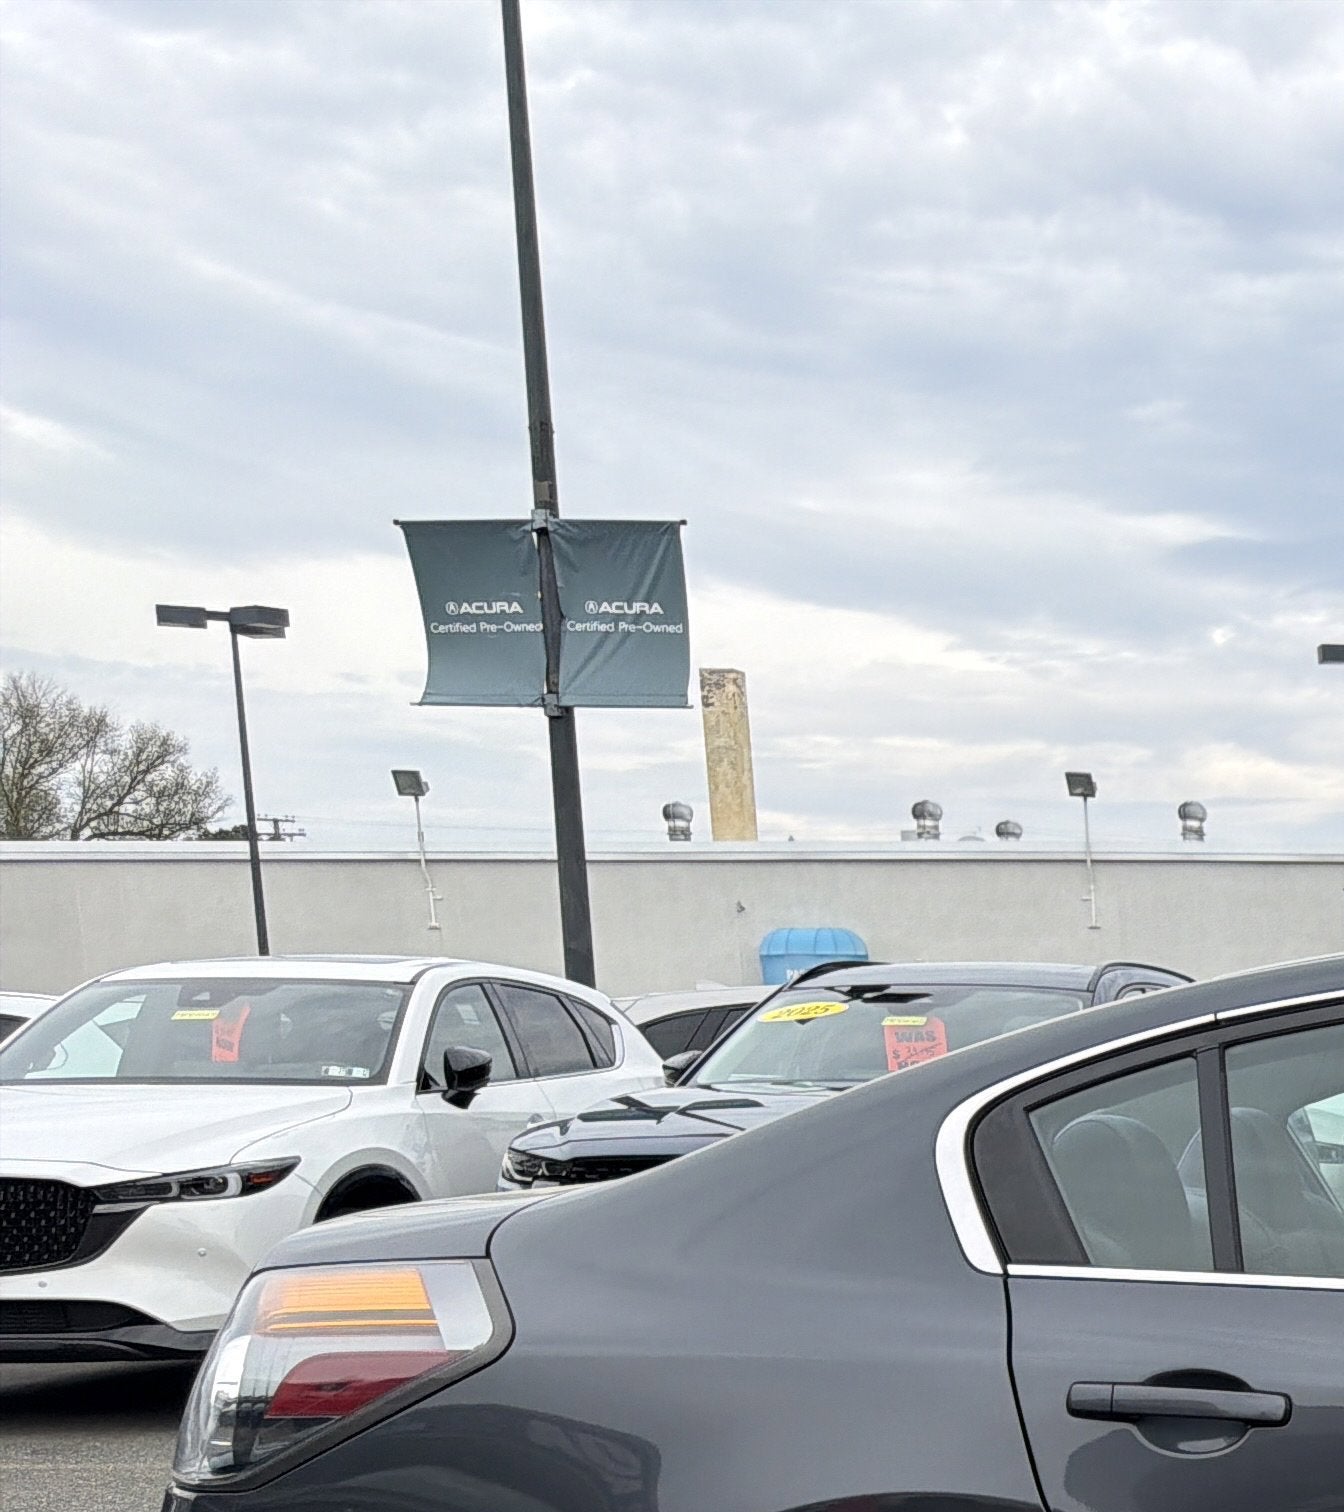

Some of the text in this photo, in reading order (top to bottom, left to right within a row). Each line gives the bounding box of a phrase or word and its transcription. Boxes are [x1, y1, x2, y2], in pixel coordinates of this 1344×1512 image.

[459, 600, 524, 615] ACURA
[598, 600, 664, 615] ACURA
[430, 621, 543, 633] Certified Pre-Owned
[566, 620, 684, 634] Certified Pre-Owned
[776, 1004, 831, 1018] 2025
[895, 1030, 937, 1043] WAS
